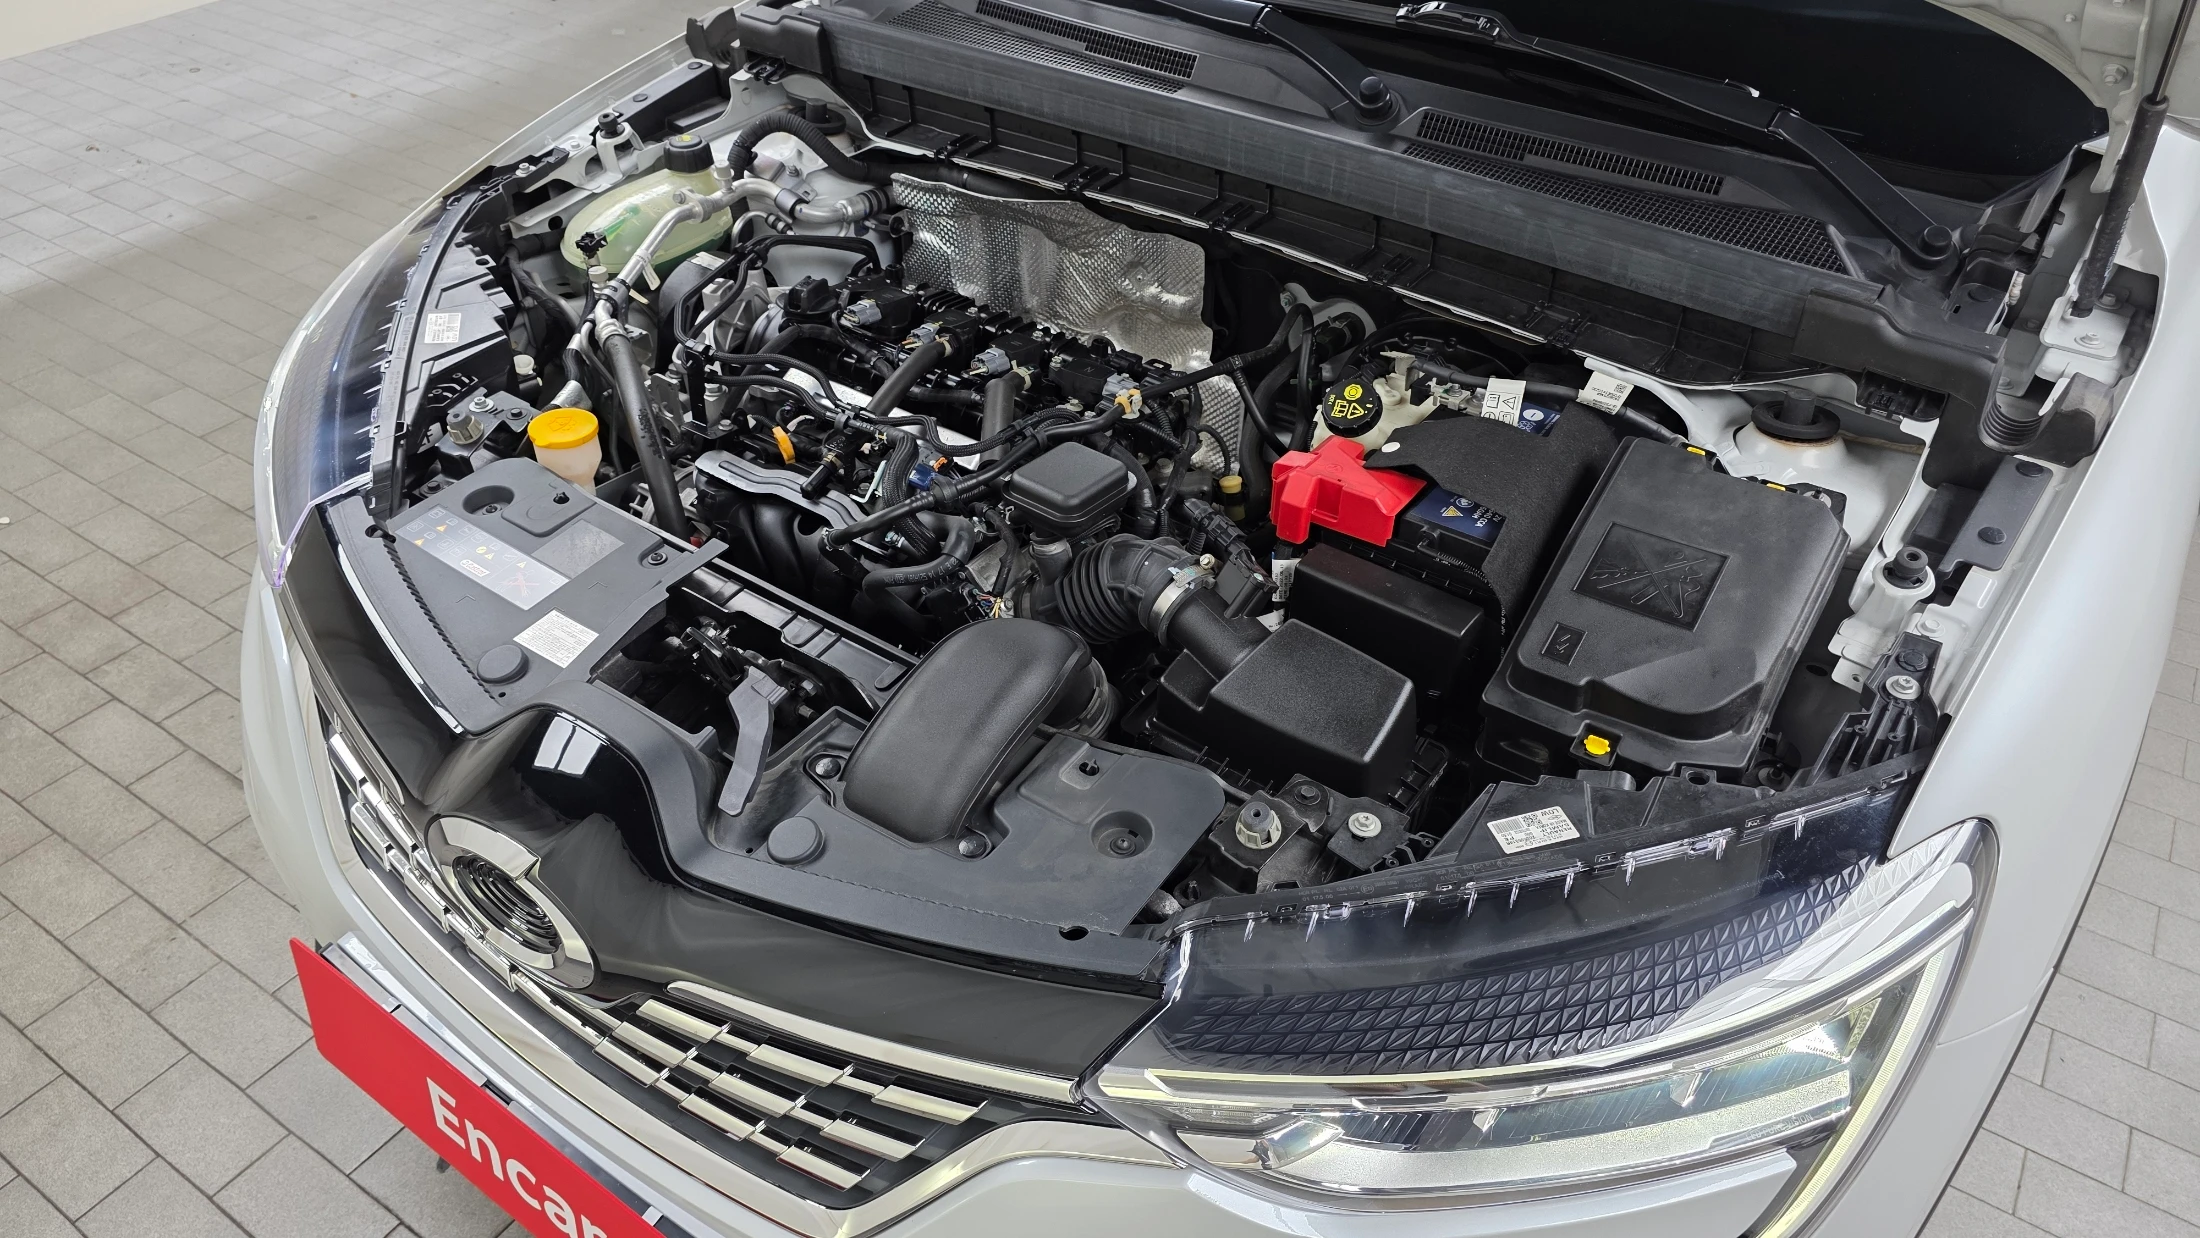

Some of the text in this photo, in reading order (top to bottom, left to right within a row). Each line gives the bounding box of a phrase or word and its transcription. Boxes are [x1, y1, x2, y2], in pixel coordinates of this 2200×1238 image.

[1474, 517, 1488, 528] CCA
[1540, 808, 1560, 818] LOW
[426, 1076, 608, 1238] Encar
